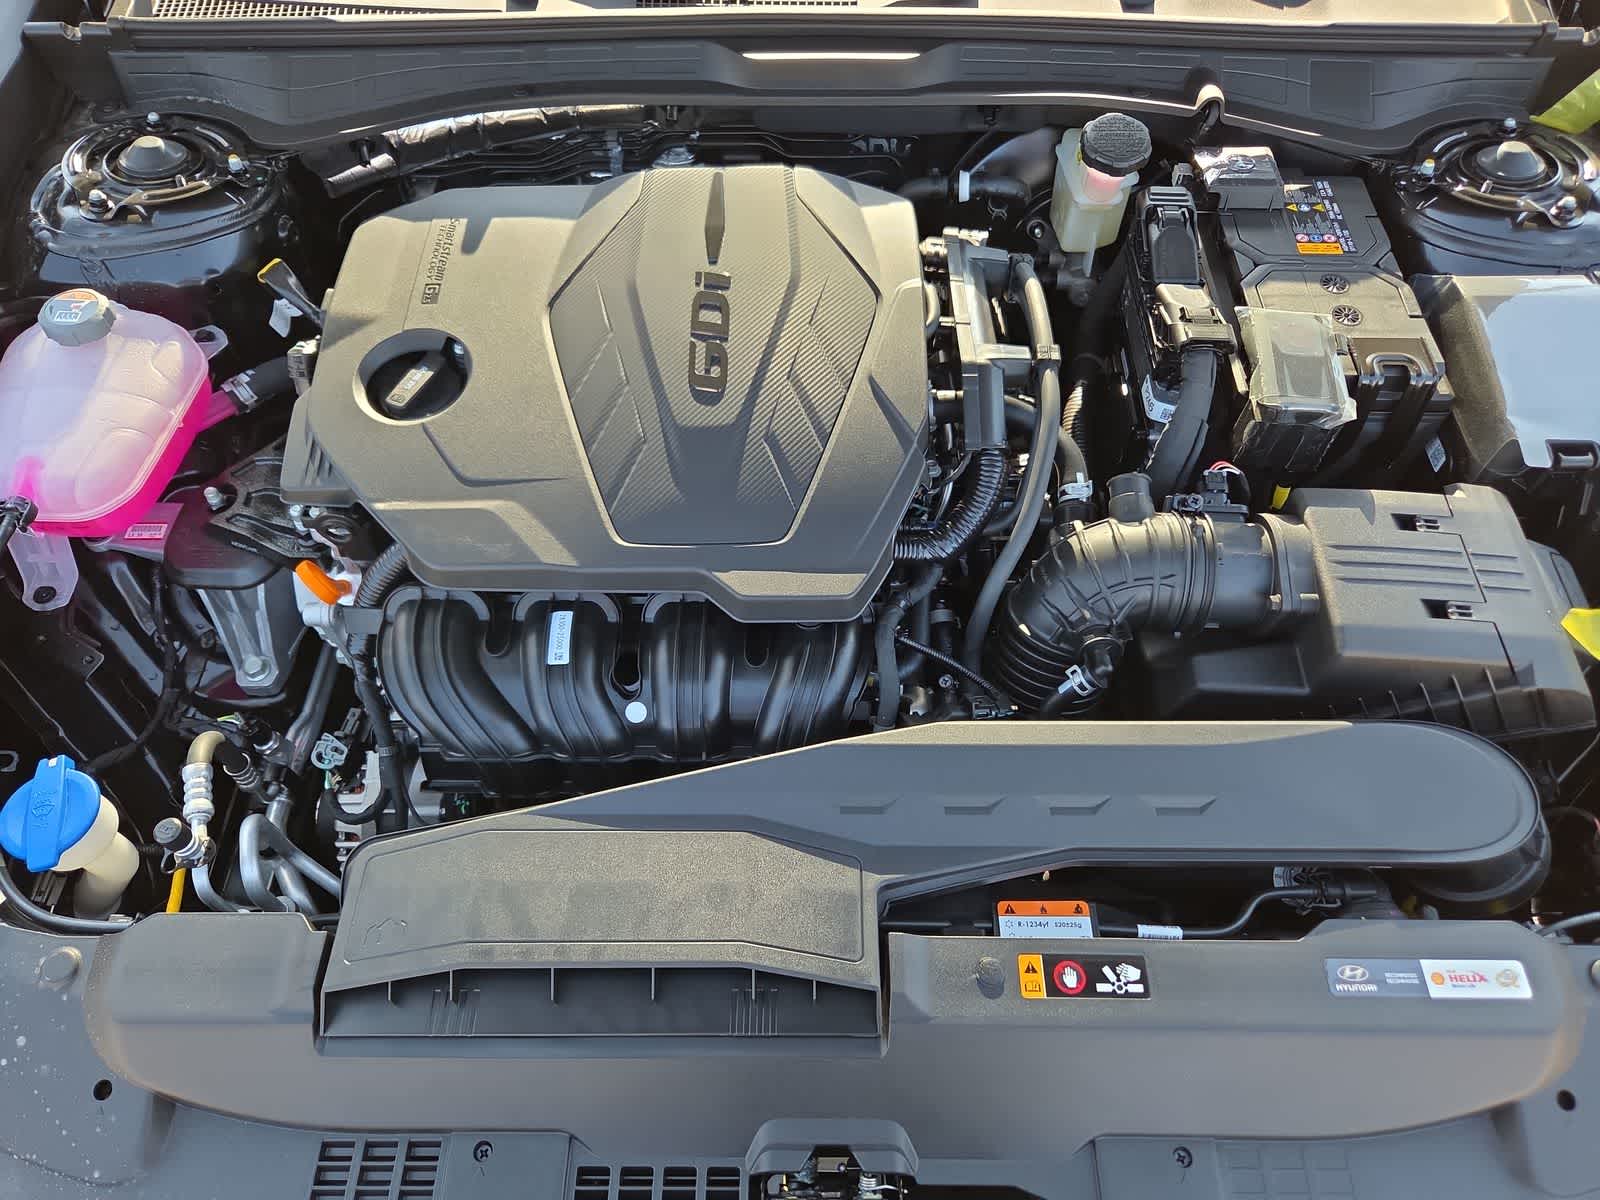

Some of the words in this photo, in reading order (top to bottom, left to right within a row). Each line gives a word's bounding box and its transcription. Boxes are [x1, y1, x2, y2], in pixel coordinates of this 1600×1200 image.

[426, 223, 448, 281] TECHNOLOGY
[433, 217, 461, 282] Smartstream
[688, 271, 732, 407] GDi
[1335, 983, 1378, 992] HYUNDAI
[1447, 972, 1488, 983] HELIX
